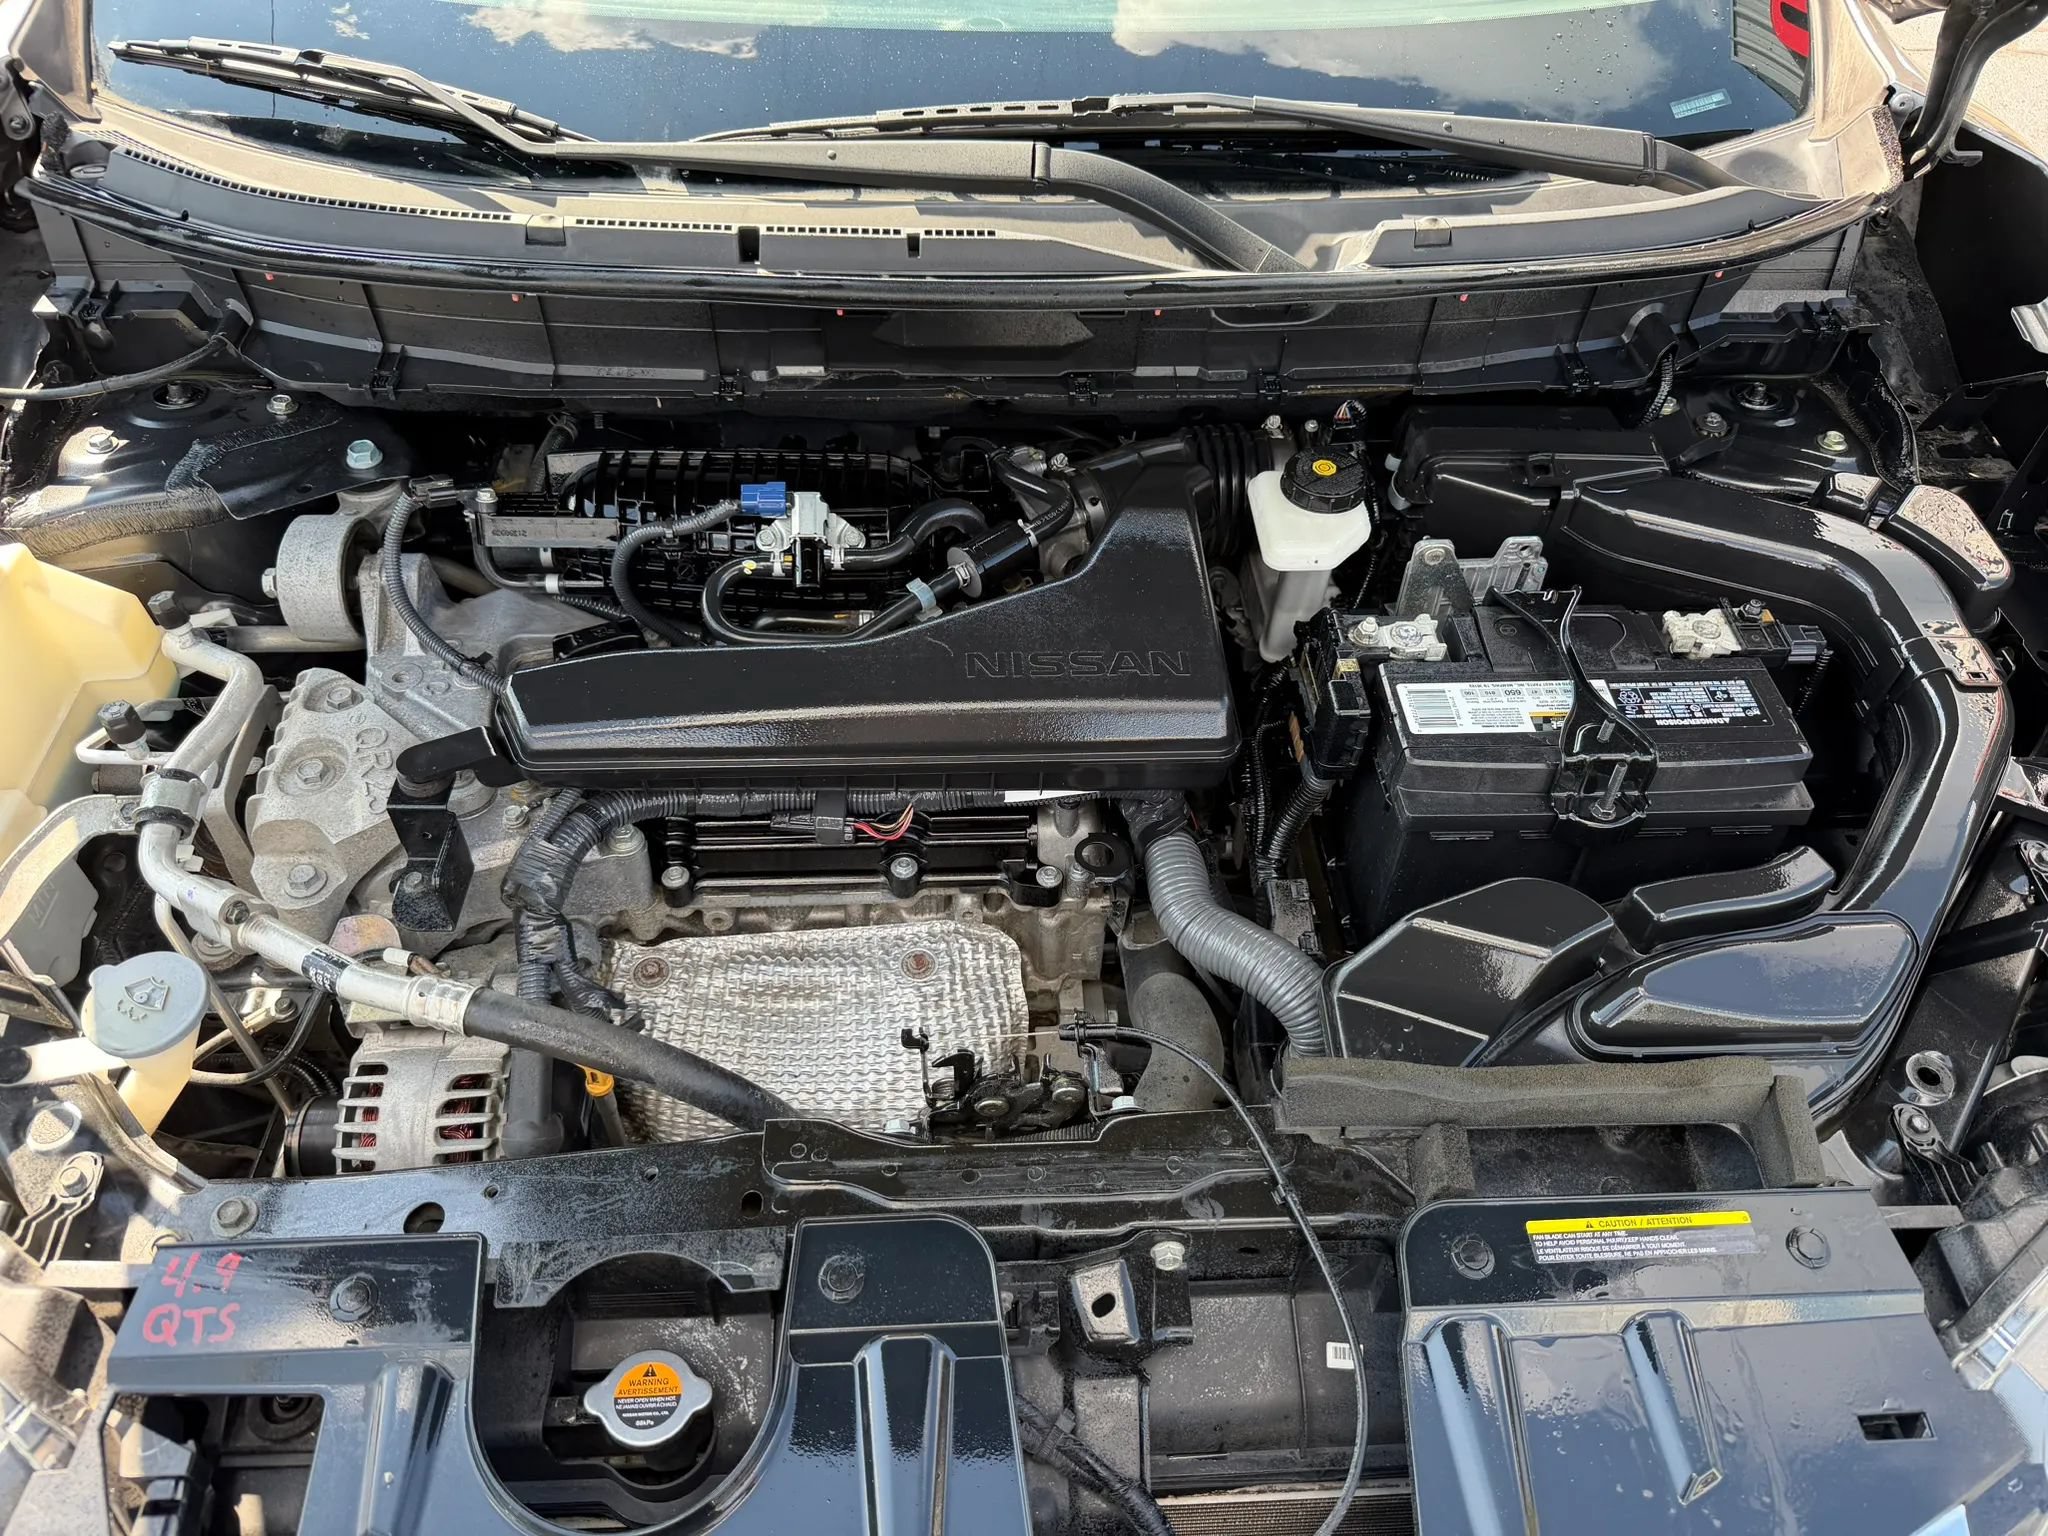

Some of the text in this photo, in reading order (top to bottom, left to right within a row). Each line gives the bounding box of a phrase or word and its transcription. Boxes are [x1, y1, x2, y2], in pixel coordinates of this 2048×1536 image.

[965, 650, 1192, 678] NISSAN
[1598, 1220, 1637, 1228] CAUTION
[1646, 1216, 1692, 1225] ATTENTION
[161, 1251, 242, 1297] 4.9
[143, 1302, 241, 1348] QTS
[618, 1386, 678, 1395] AVERTISSEMENT
[628, 1378, 669, 1387] WARNING
